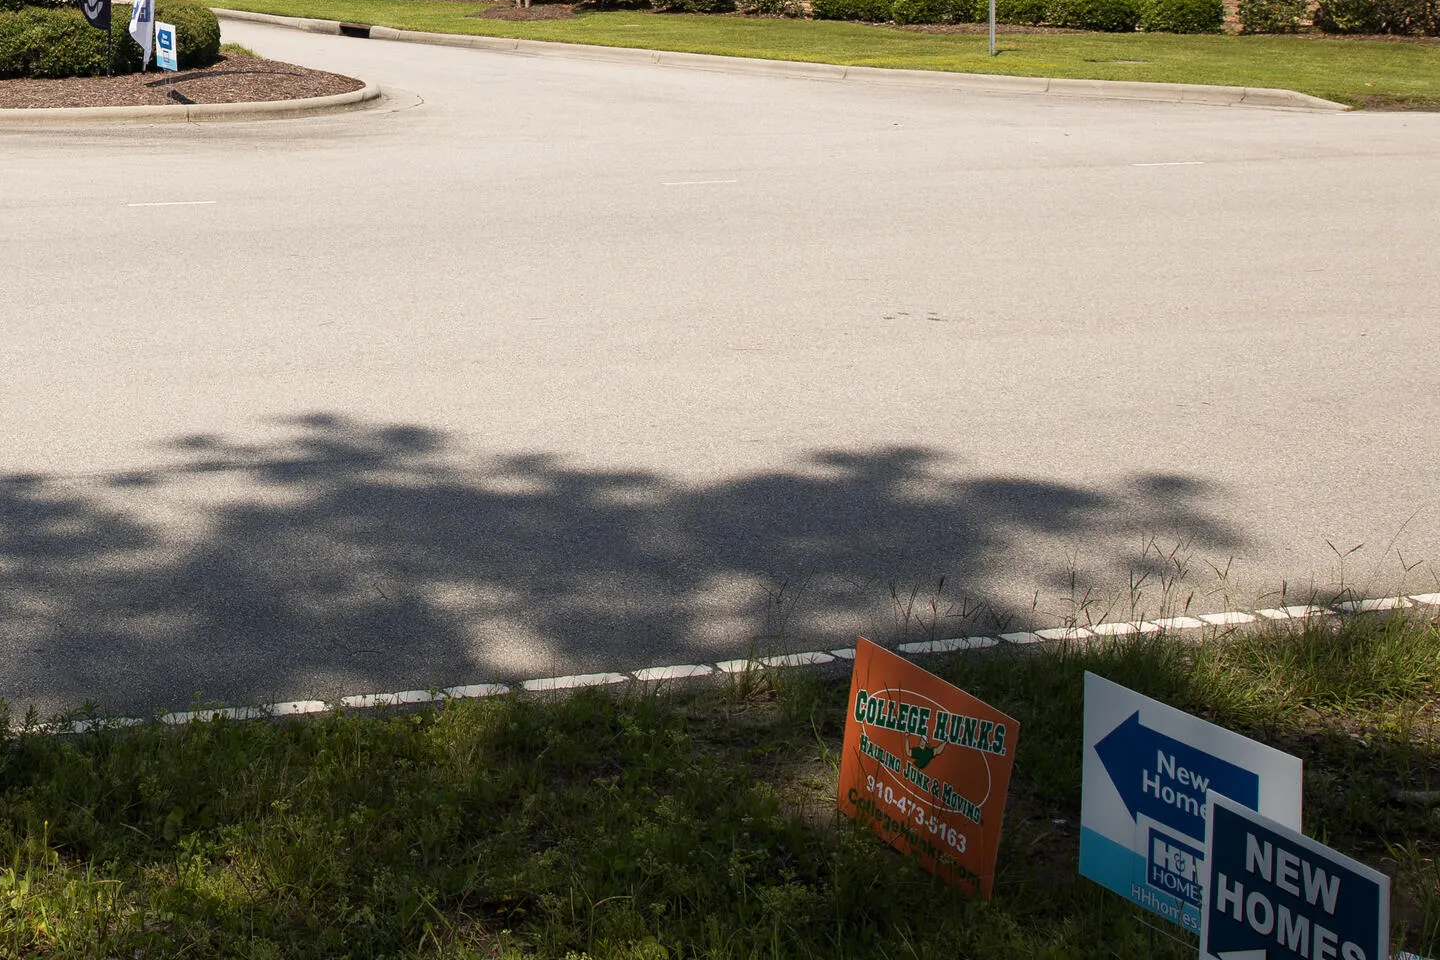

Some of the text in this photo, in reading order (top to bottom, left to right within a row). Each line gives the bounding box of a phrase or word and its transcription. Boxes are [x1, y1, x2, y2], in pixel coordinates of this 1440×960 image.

[854, 689, 931, 738] COLLEGE
[859, 733, 981, 825] HAULING JUNK & MOVING
[1142, 768, 1206, 820] Home
[1157, 749, 1210, 793] New
[866, 775, 967, 854] 910-473-5163
[1153, 865, 1203, 902] HOME
[1245, 832, 1341, 916] NEW
